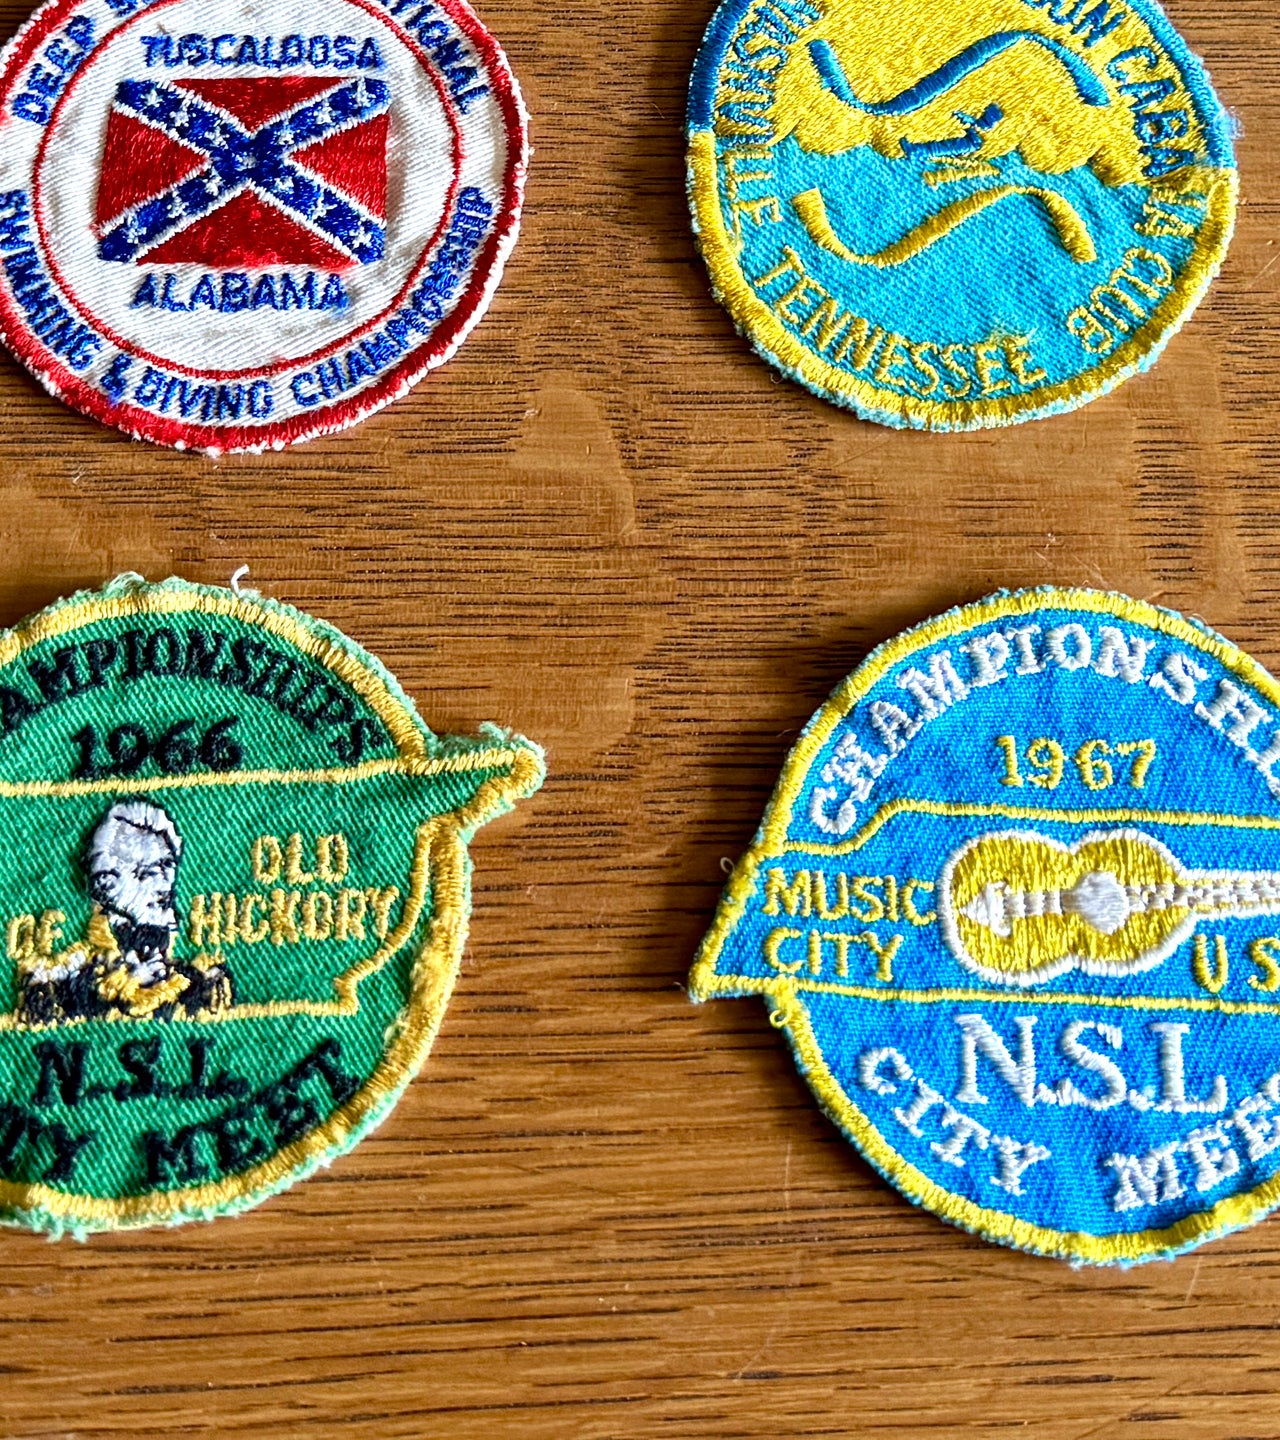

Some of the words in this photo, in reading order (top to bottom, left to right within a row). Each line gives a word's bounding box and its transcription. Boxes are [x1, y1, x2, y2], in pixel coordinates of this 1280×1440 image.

[10, 14, 98, 127] DEEP
[138, 34, 384, 70] TUSCALOOSA
[129, 272, 352, 315] ALABAMA
[133, 365, 276, 423] DIVING
[290, 186, 494, 407] CHAMPIONSHIP
[753, 244, 1047, 398] TENNESSEE
[1064, 246, 1174, 356] CLUB
[71, 718, 247, 777] 1966
[996, 734, 1157, 790] 1967
[250, 832, 349, 886] OLD
[189, 887, 401, 949] HICKORY
[760, 866, 937, 926] MUSIC
[5, 911, 65, 961] OF
[764, 927, 903, 983] CITY
[141, 1040, 363, 1186] MEET
[858, 1046, 1051, 1196] CITY
